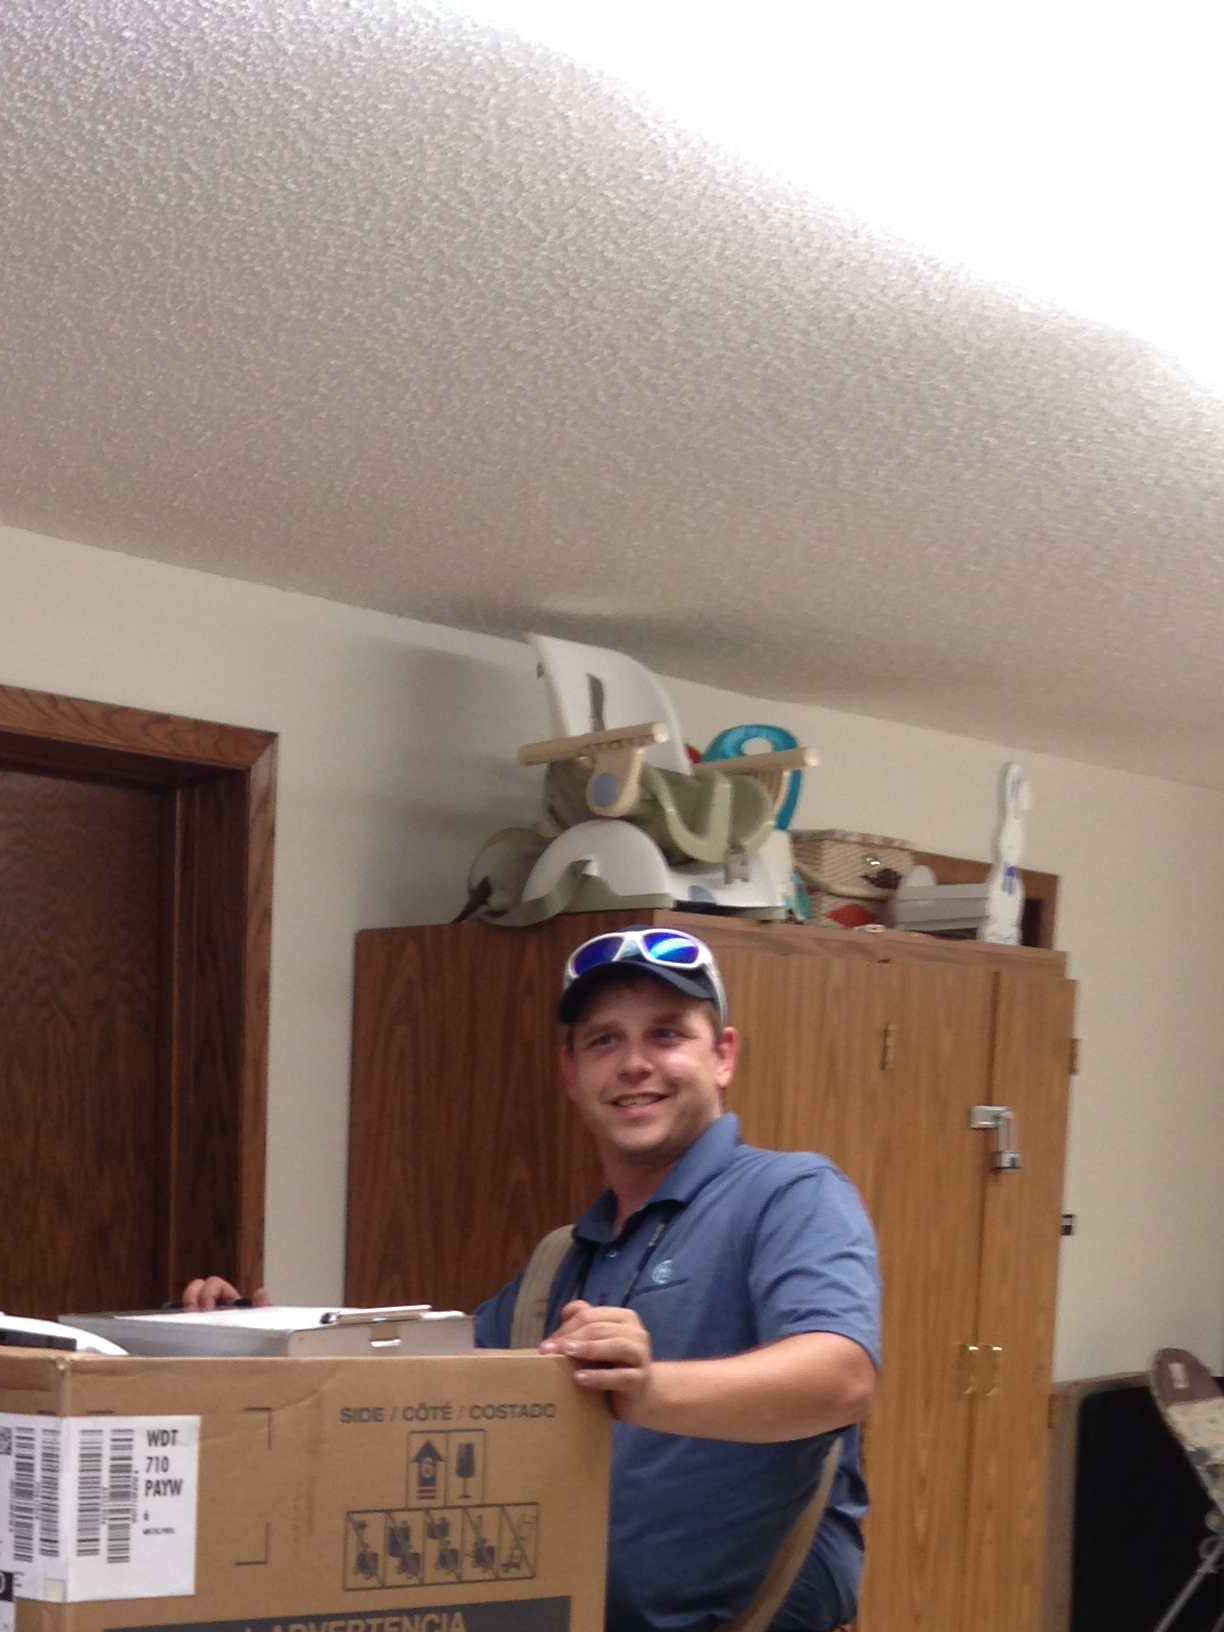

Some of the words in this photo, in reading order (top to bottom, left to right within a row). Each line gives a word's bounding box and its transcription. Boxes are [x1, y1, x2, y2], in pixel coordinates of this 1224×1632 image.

[340, 1406, 384, 1424] SIDE
[401, 1401, 452, 1422] CÔTÉ
[469, 1403, 557, 1420] COSTADO
[146, 1428, 178, 1448] WDT
[146, 1456, 169, 1474] 710
[144, 1478, 184, 1498] PAYW
